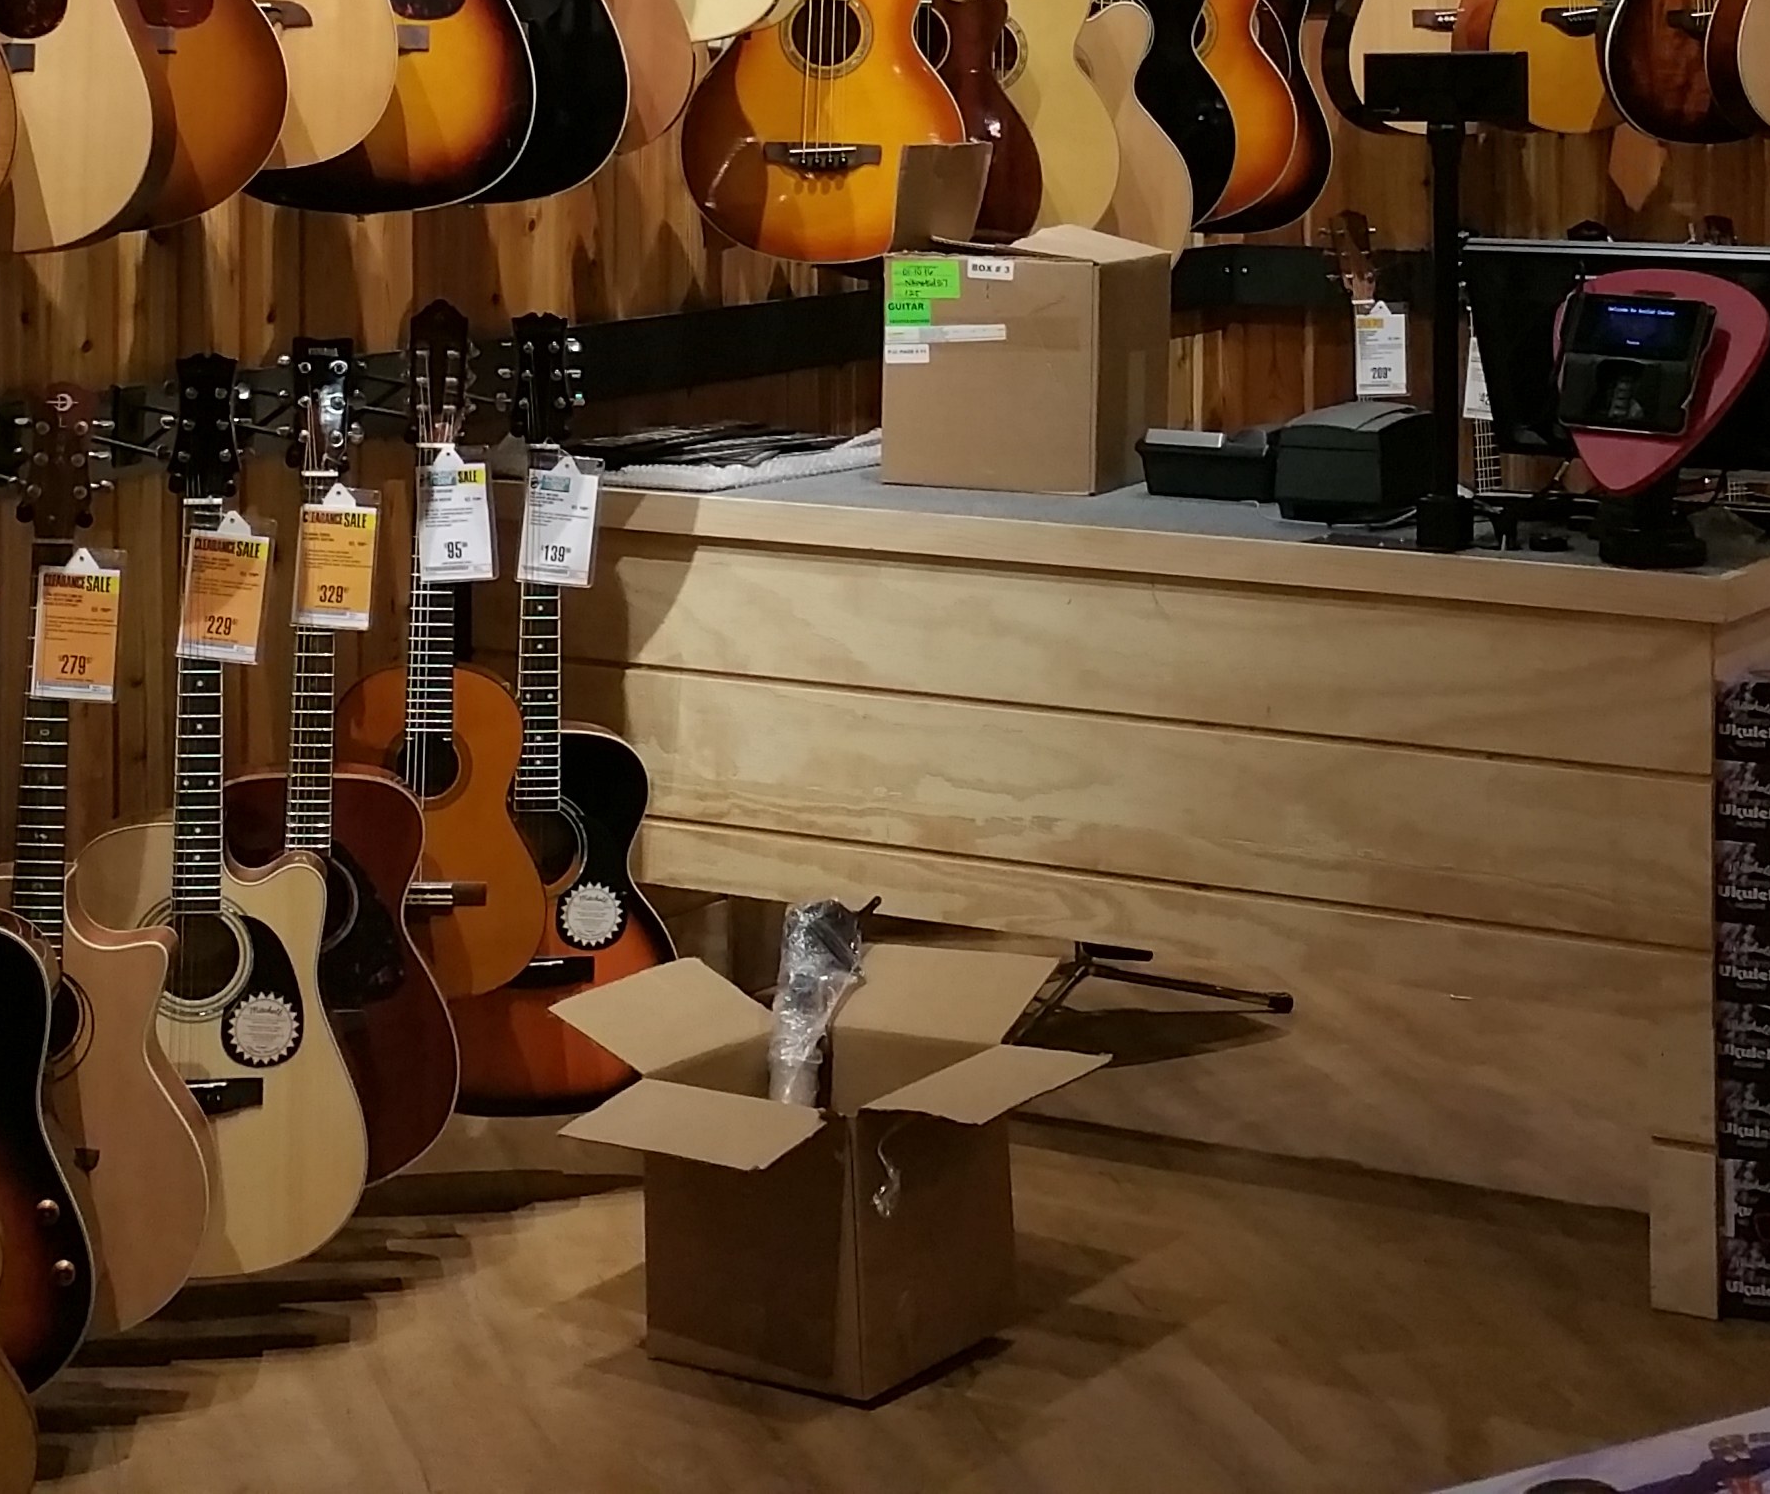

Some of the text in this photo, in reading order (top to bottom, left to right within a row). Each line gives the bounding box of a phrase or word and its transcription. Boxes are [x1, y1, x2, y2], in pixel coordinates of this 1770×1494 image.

[887, 302, 925, 311] GUITAR
[458, 470, 477, 483] SALE
[344, 512, 367, 528] SALE
[236, 540, 260, 559] SALE
[86, 576, 111, 593] SALE
